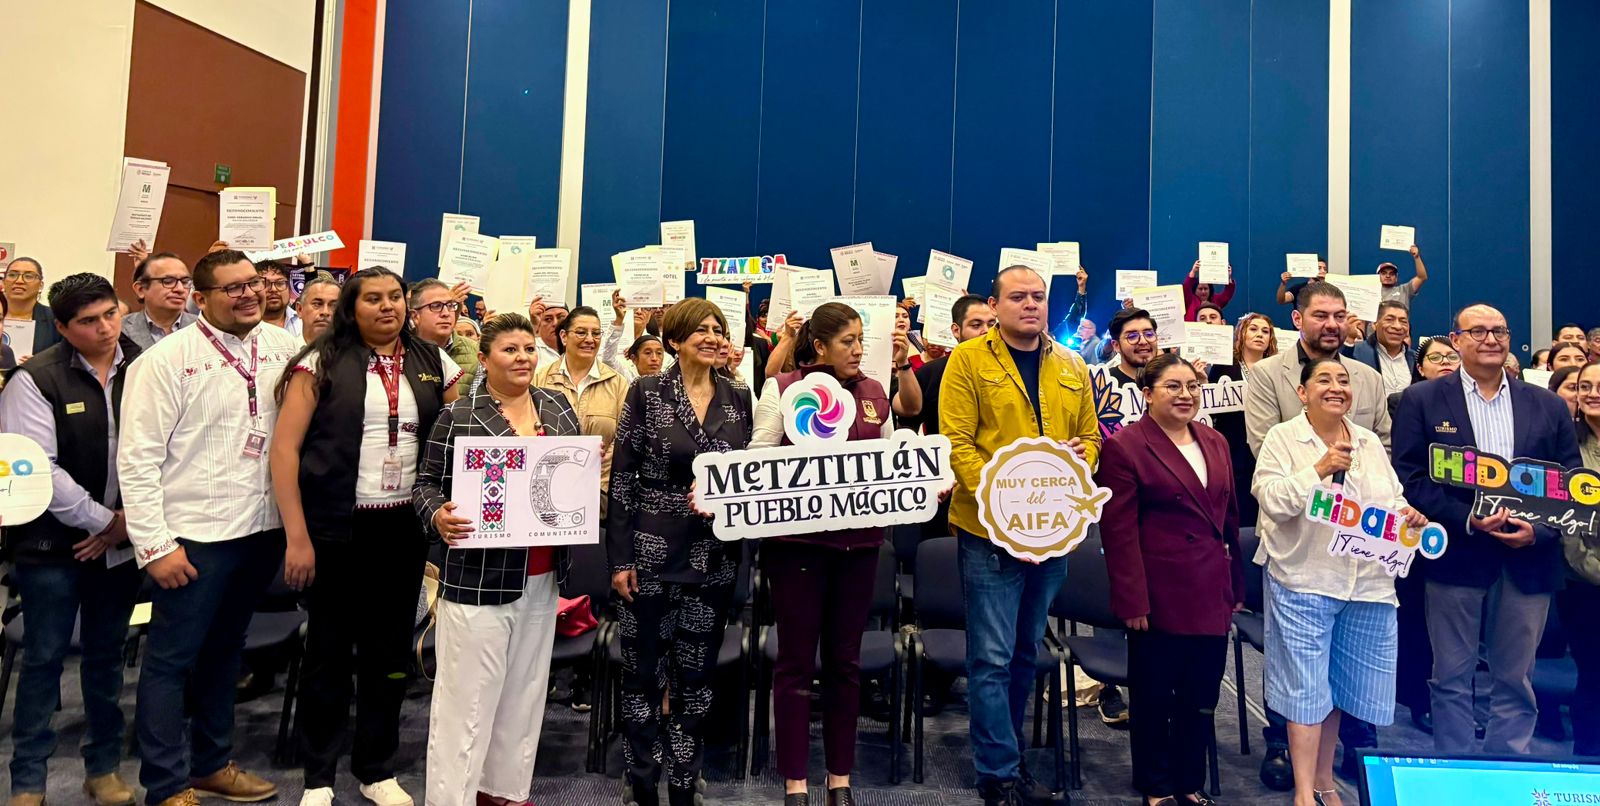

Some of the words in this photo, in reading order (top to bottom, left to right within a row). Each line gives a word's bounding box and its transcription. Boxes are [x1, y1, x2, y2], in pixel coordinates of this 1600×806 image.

[996, 478, 1028, 489] MUY
[1030, 476, 1077, 488] CERCA
[1026, 490, 1046, 505] del
[1007, 511, 1070, 531] AIFA
[1477, 491, 1541, 519] ¡Tene
[1548, 508, 1597, 535] algo!
[1379, 550, 1412, 574] algo!
